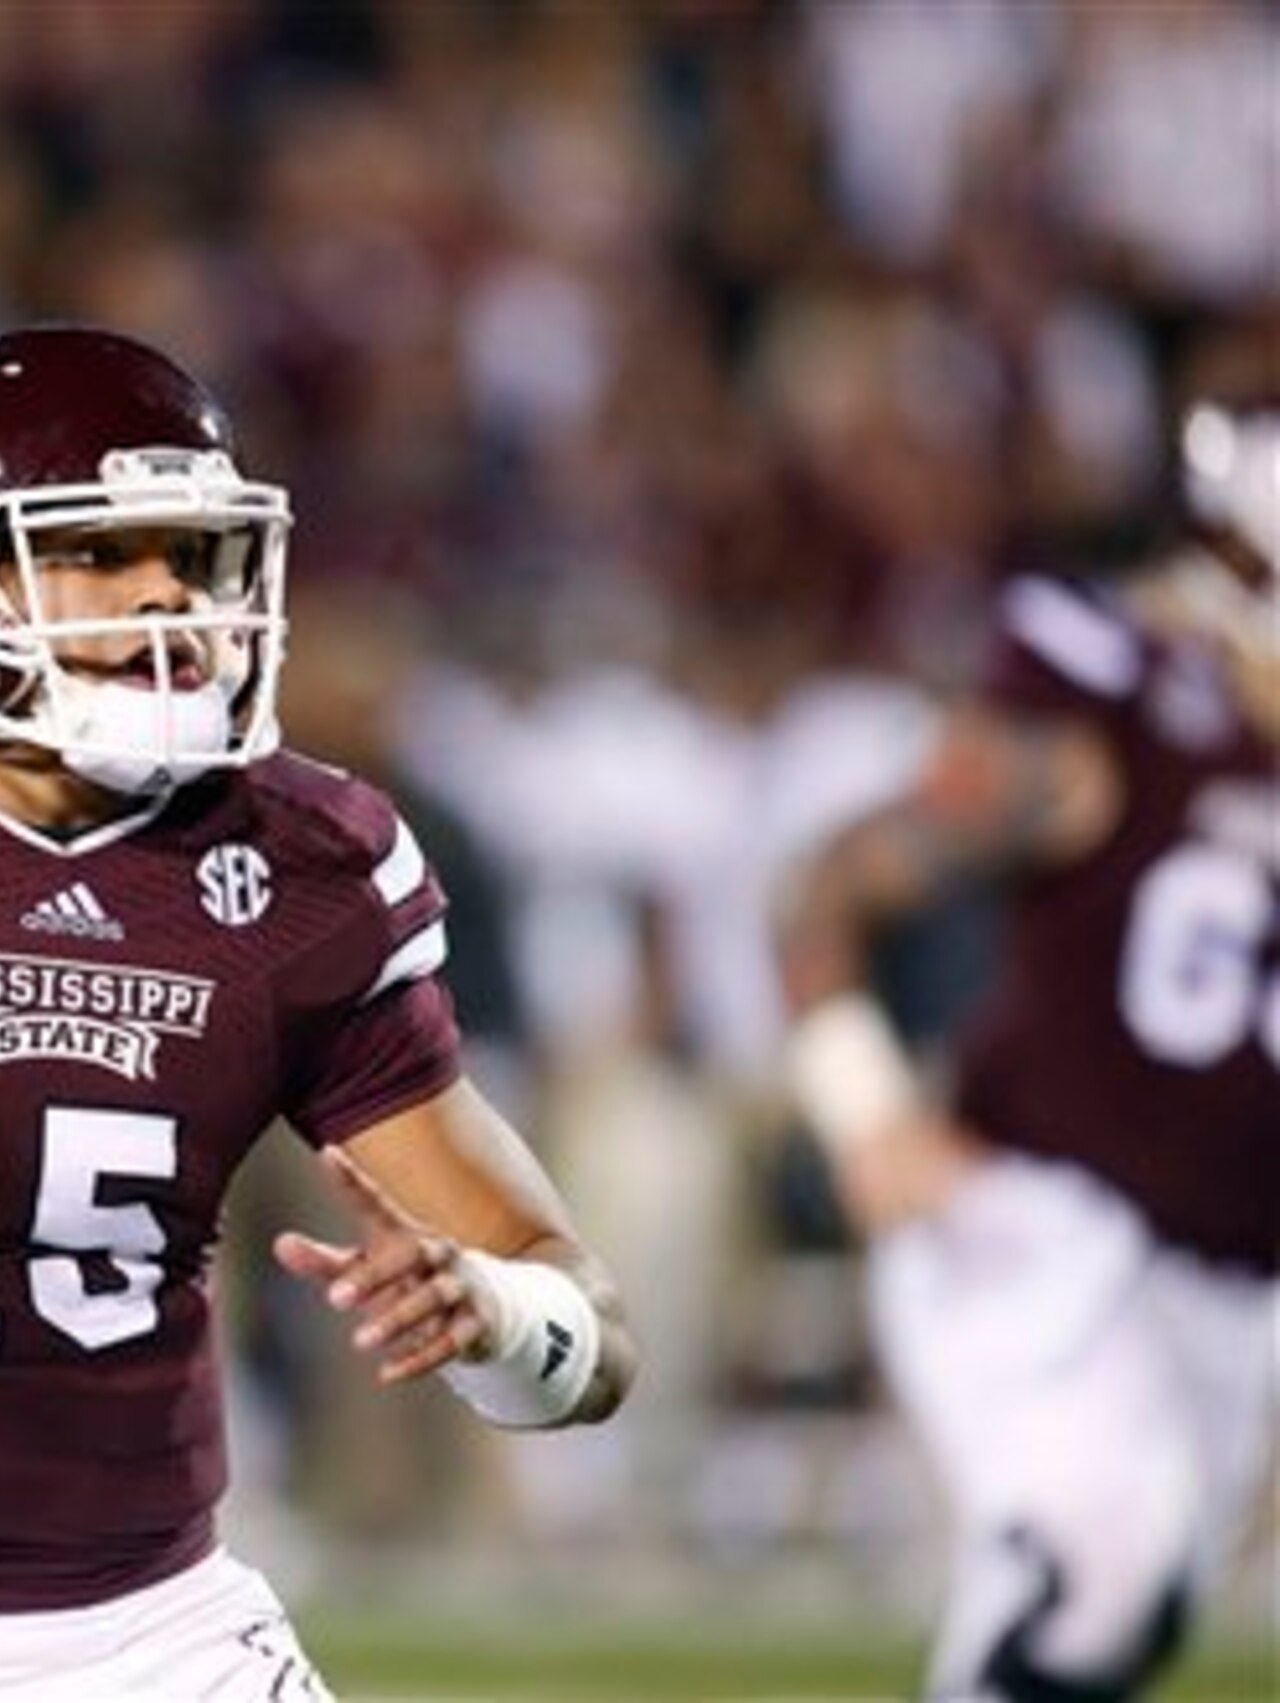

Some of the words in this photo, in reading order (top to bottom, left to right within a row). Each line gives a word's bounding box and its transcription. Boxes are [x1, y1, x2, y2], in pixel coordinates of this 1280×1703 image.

[195, 844, 272, 924] SEC
[19, 911, 125, 942] adidas
[1120, 843, 1280, 1069] 6
